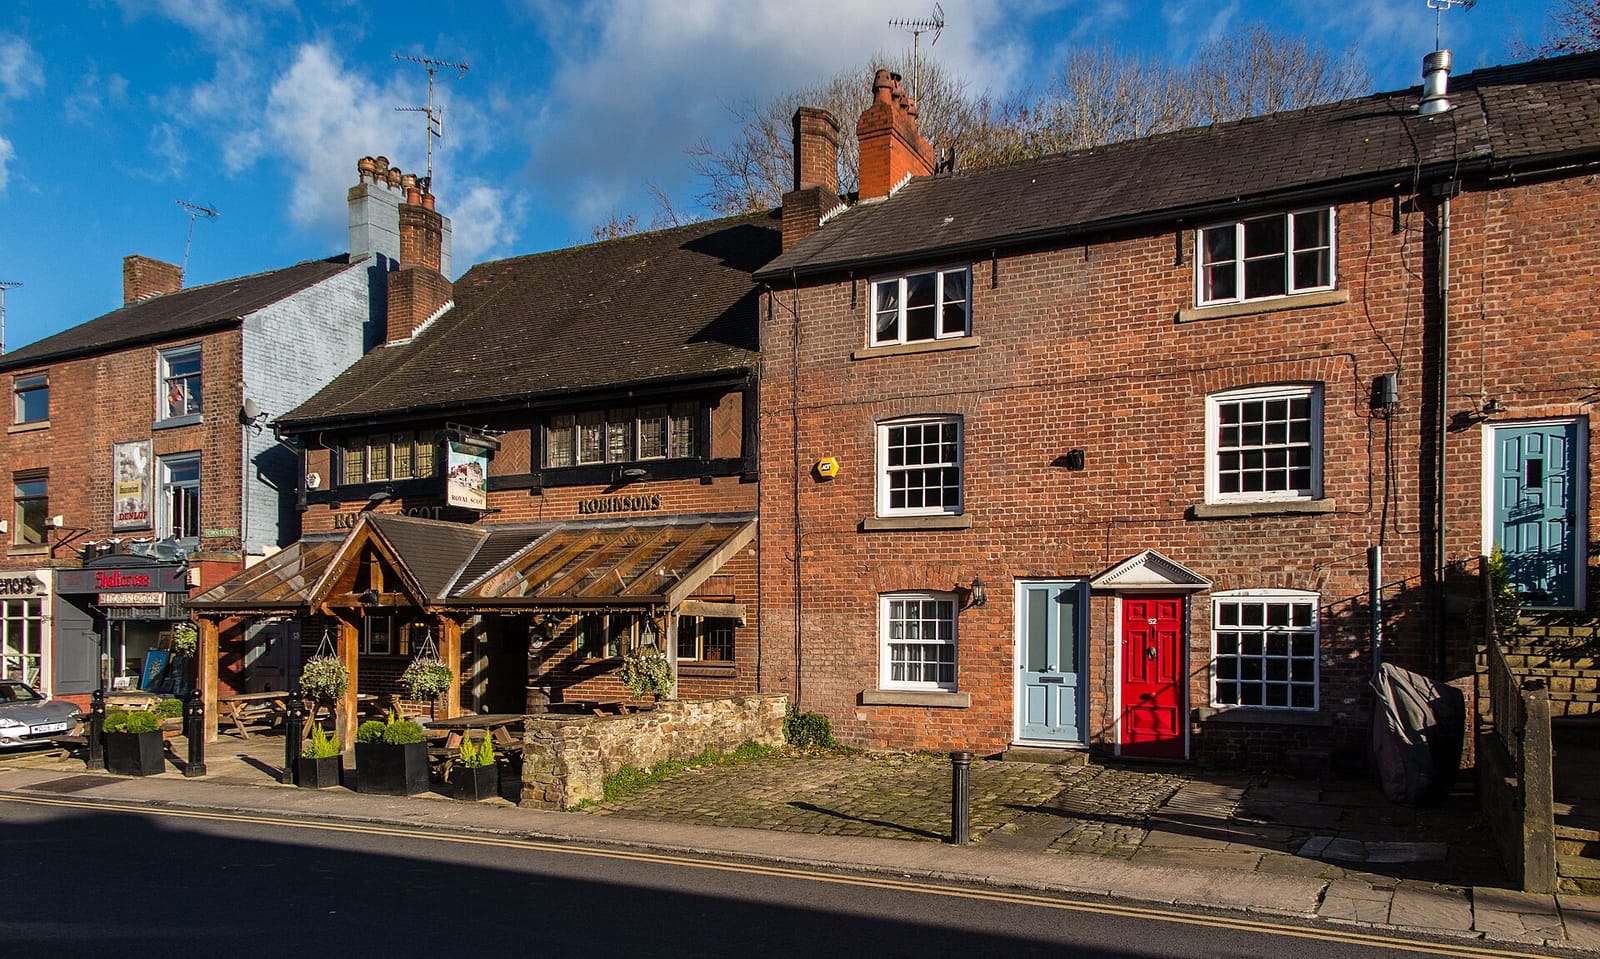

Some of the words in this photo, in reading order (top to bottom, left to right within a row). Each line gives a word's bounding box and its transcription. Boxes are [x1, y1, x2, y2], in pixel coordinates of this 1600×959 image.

[451, 495, 468, 503] ROYAL
[578, 495, 660, 514] ROBINSONS
[119, 512, 148, 521] DUNLOP
[94, 570, 150, 588] Shallcross
